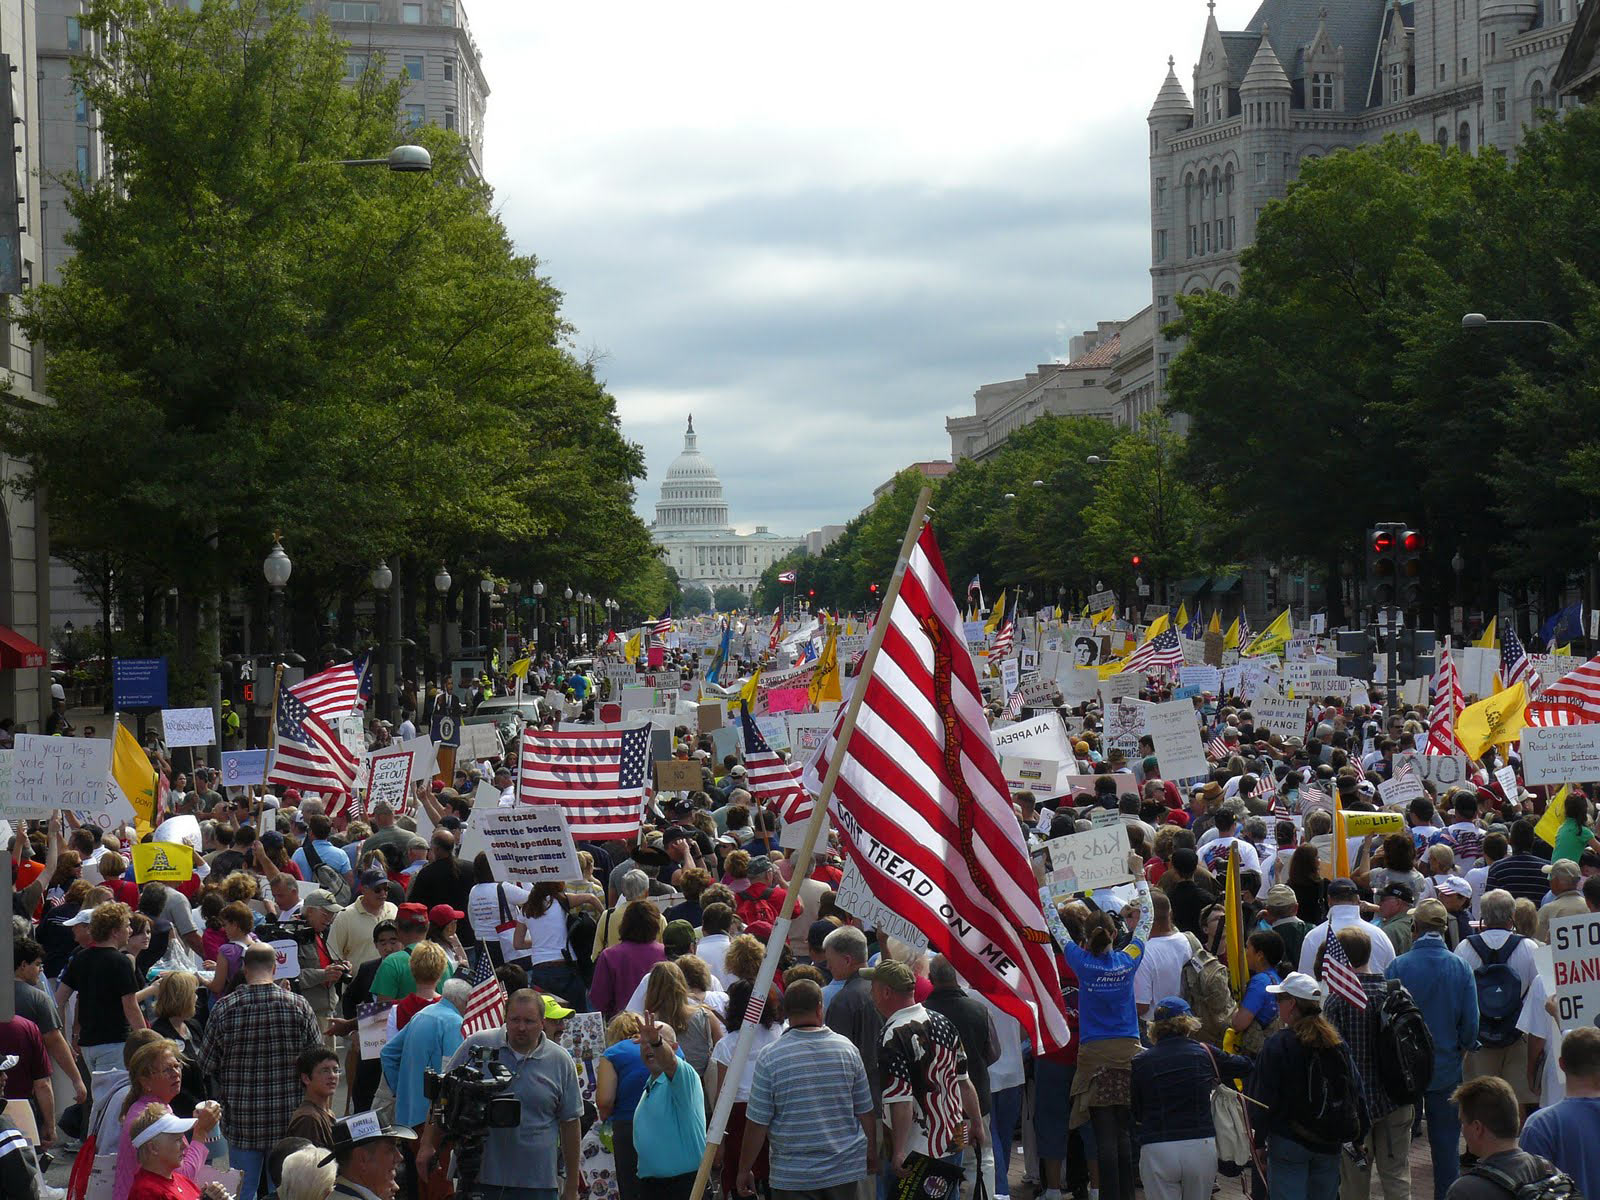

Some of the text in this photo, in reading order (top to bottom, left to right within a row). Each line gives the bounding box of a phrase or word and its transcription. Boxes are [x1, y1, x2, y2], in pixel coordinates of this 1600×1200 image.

[1311, 681, 1322, 690] TAX
[244, 684, 253, 700] 16
[1263, 698, 1300, 708] TRUTH
[1260, 720, 1299, 730] CHANGE
[1537, 729, 1582, 741] Congress
[21, 737, 34, 752] If
[42, 743, 64, 758] your
[1529, 741, 1548, 751] Read
[1558, 741, 1595, 750] understand
[1548, 750, 1600, 761] bills Before
[20, 758, 45, 769] vote
[52, 756, 73, 771] Tax
[375, 768, 406, 780] GET OUT
[1409, 755, 1460, 784] NO
[1540, 763, 1600, 777] you sign them
[16, 788, 34, 801] out
[61, 790, 98, 804] 2010!
[498, 813, 537, 822] cut taxes
[1354, 818, 1371, 826] AND
[1372, 814, 1399, 826] LIFE
[510, 827, 525, 836] the
[526, 825, 562, 834] borders
[491, 838, 562, 849] control spending
[515, 852, 567, 863] government
[508, 865, 560, 875] america first
[867, 838, 933, 897] TREAD
[939, 903, 972, 938] ON
[979, 943, 1016, 976] ME
[837, 887, 927, 948] FOR QUESTIONING
[1559, 995, 1584, 1020] OF
[364, 1040, 378, 1048] Stop
[352, 1117, 373, 1128] DRILL
[358, 1125, 376, 1135] NOW
